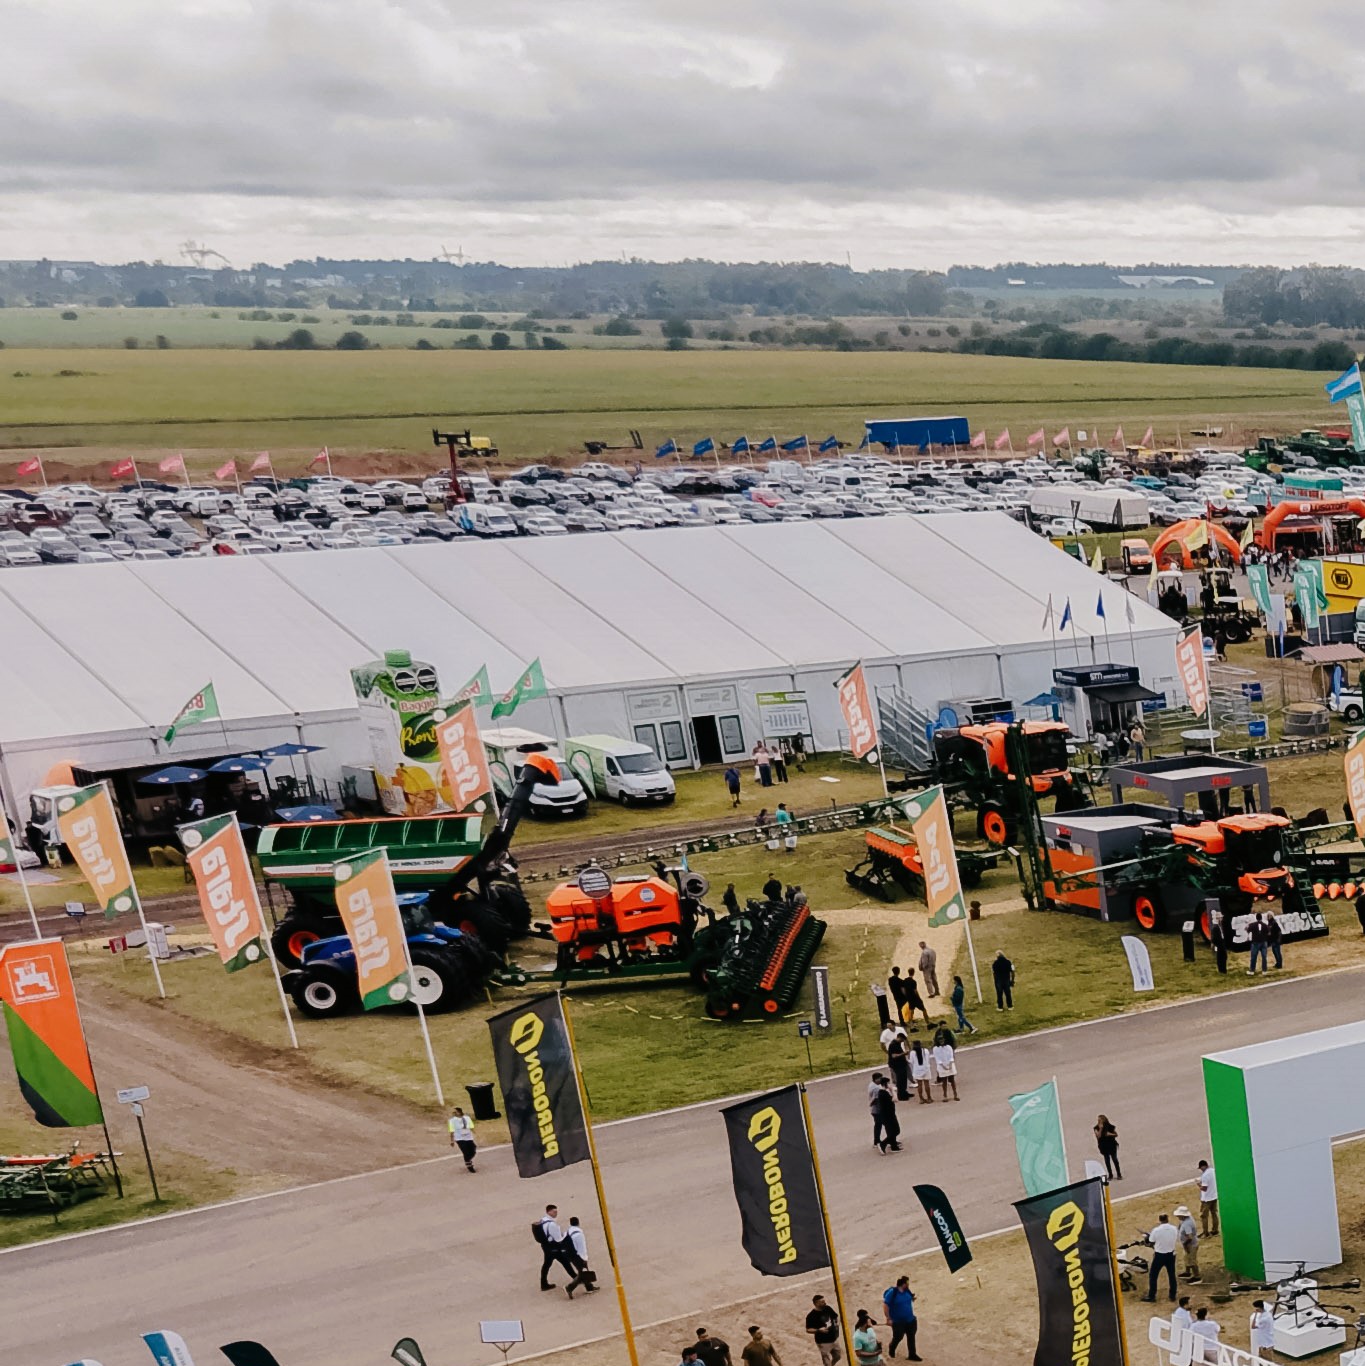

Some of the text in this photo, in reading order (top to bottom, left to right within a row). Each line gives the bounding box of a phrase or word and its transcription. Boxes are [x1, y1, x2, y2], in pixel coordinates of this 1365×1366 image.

[400, 699, 437, 714] Baggio
[400, 724, 439, 754] Pront
[933, 1208, 957, 1254] BANCOR
